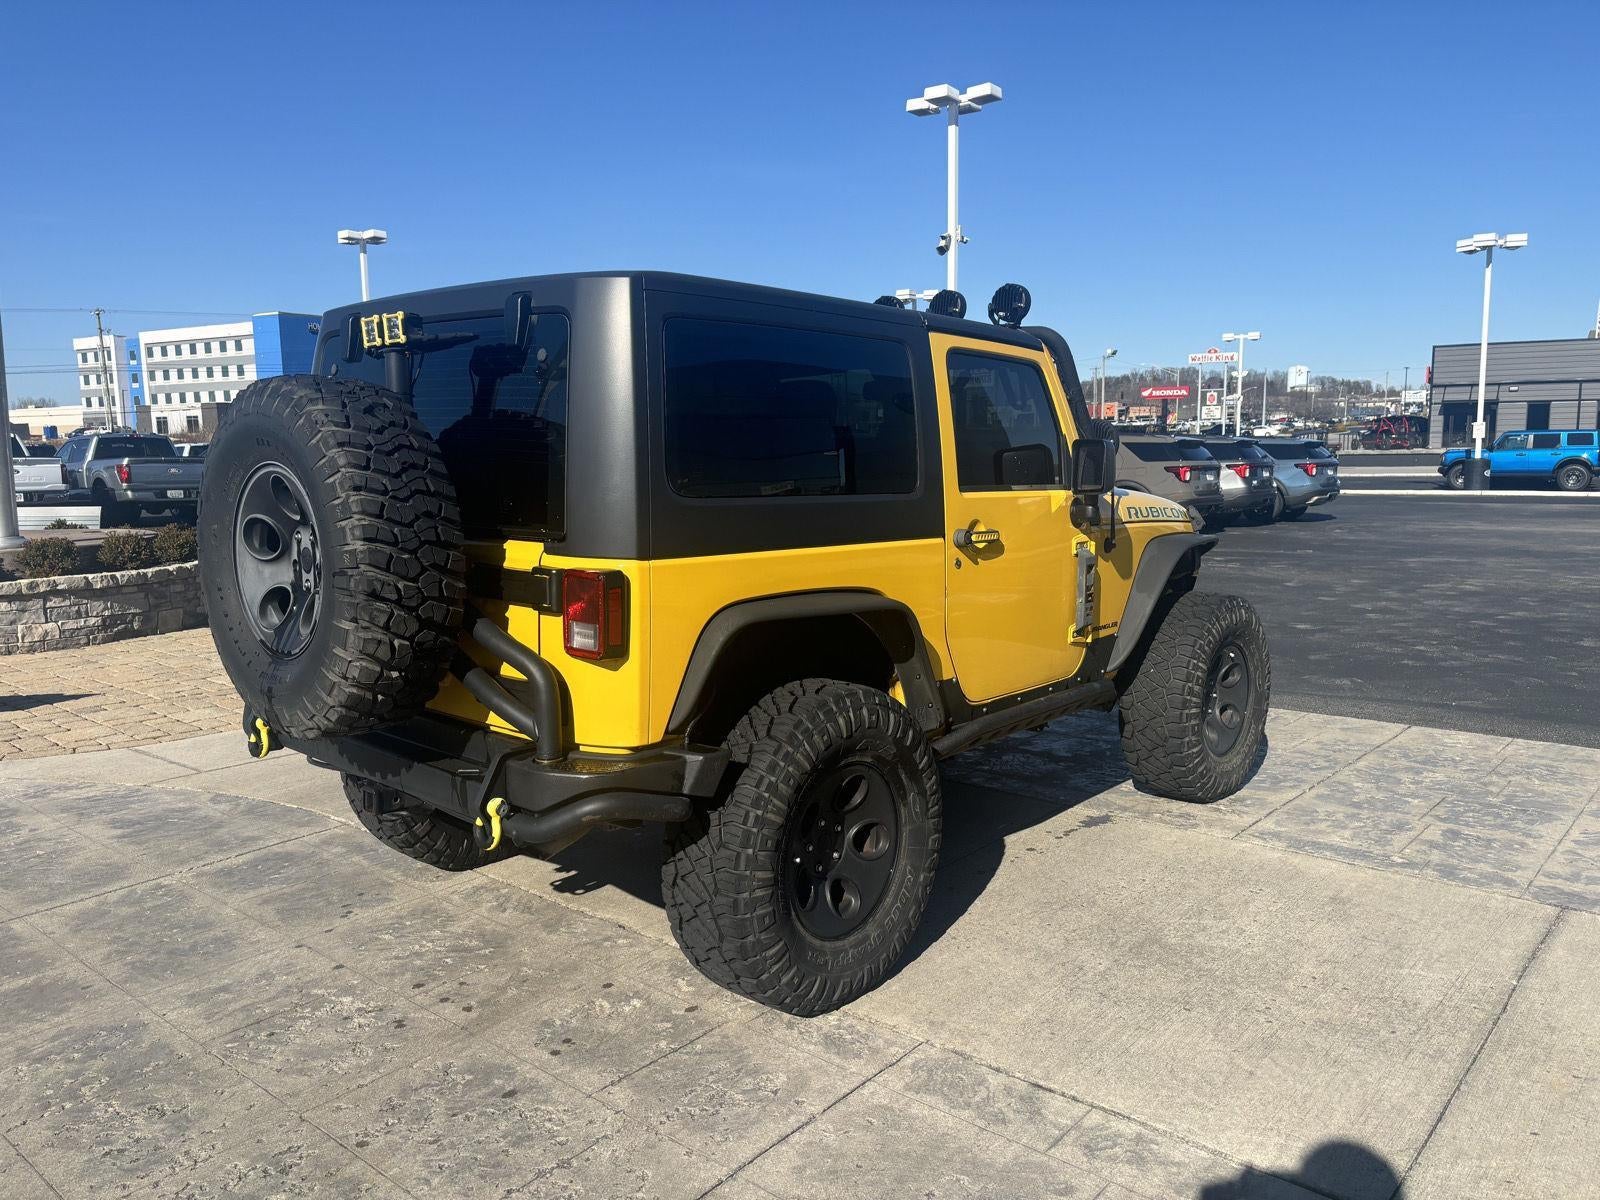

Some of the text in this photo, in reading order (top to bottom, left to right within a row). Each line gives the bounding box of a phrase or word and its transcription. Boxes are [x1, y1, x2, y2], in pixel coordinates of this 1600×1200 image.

[1215, 353, 1235, 361] King
[1151, 388, 1188, 397] HONDA
[1126, 506, 1189, 519] RUBICON
